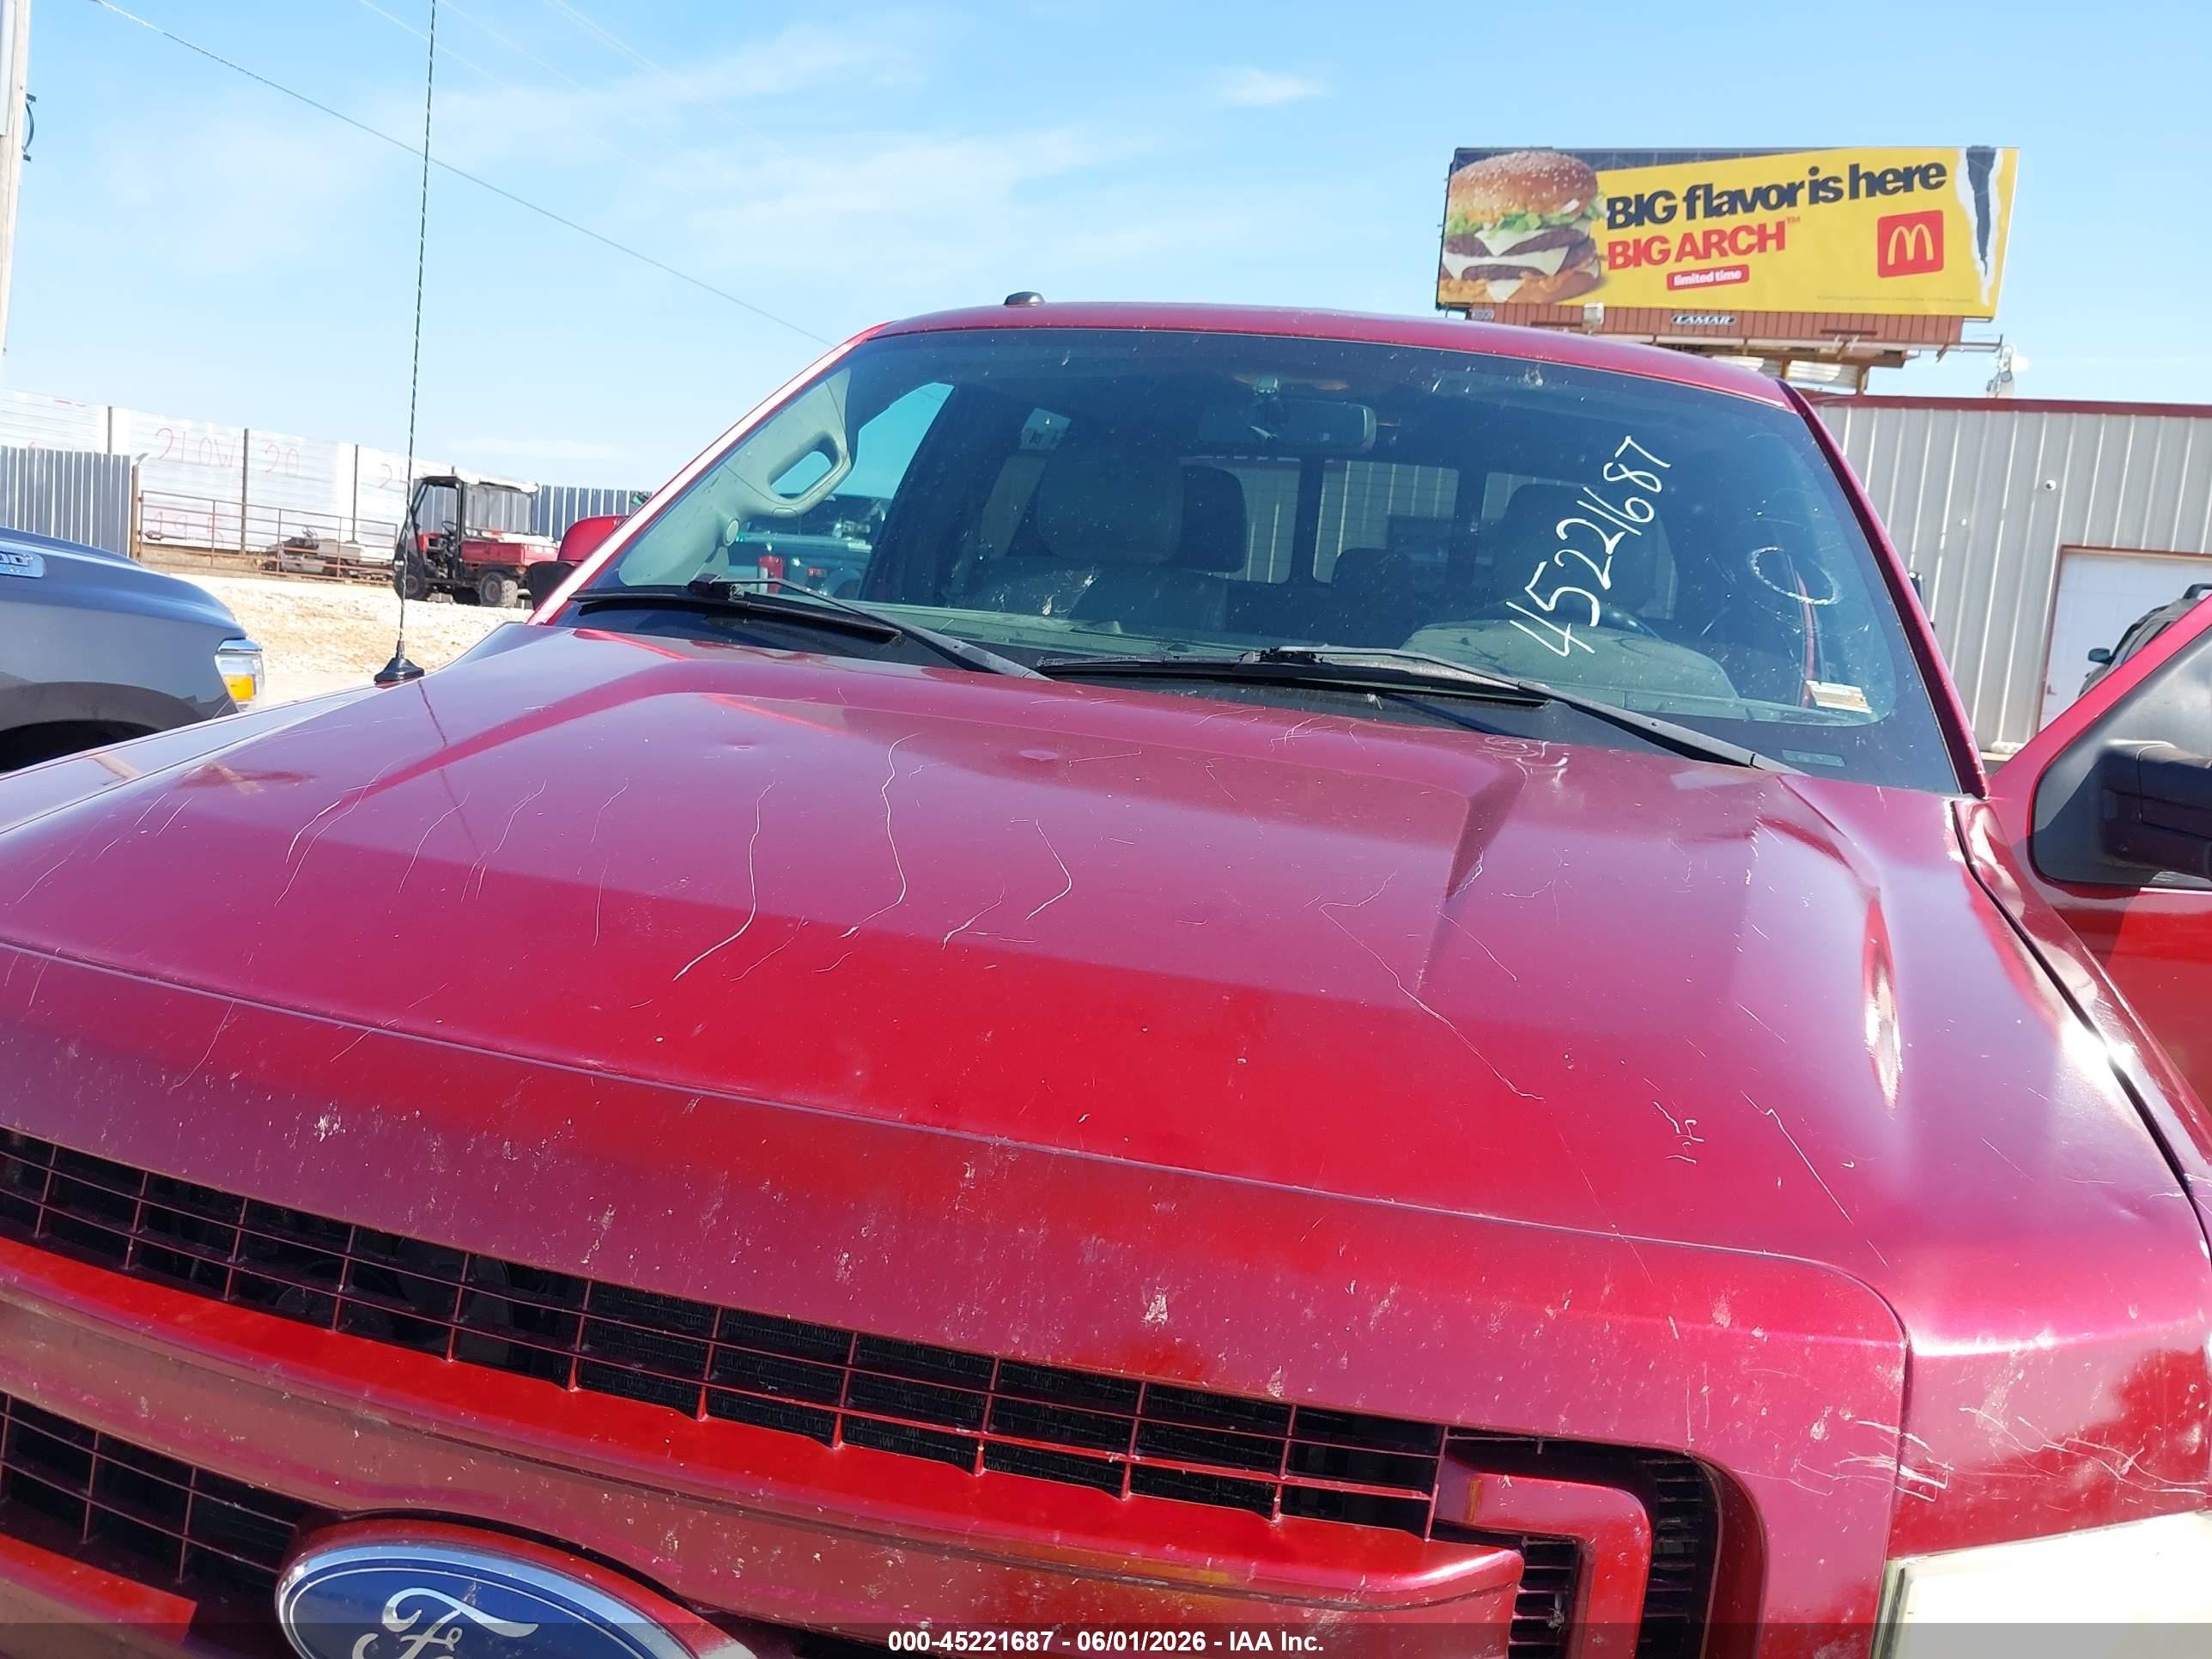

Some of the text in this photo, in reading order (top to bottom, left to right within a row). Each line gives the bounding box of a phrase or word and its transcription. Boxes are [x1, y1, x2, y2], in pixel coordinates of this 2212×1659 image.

[1607, 161, 1948, 230] BIG flavor is here
[1607, 235, 1672, 270] BIG
[1673, 268, 1742, 287] limited time
[1674, 314, 1731, 325] LAMAR
[1505, 434, 1672, 657] 45221687
